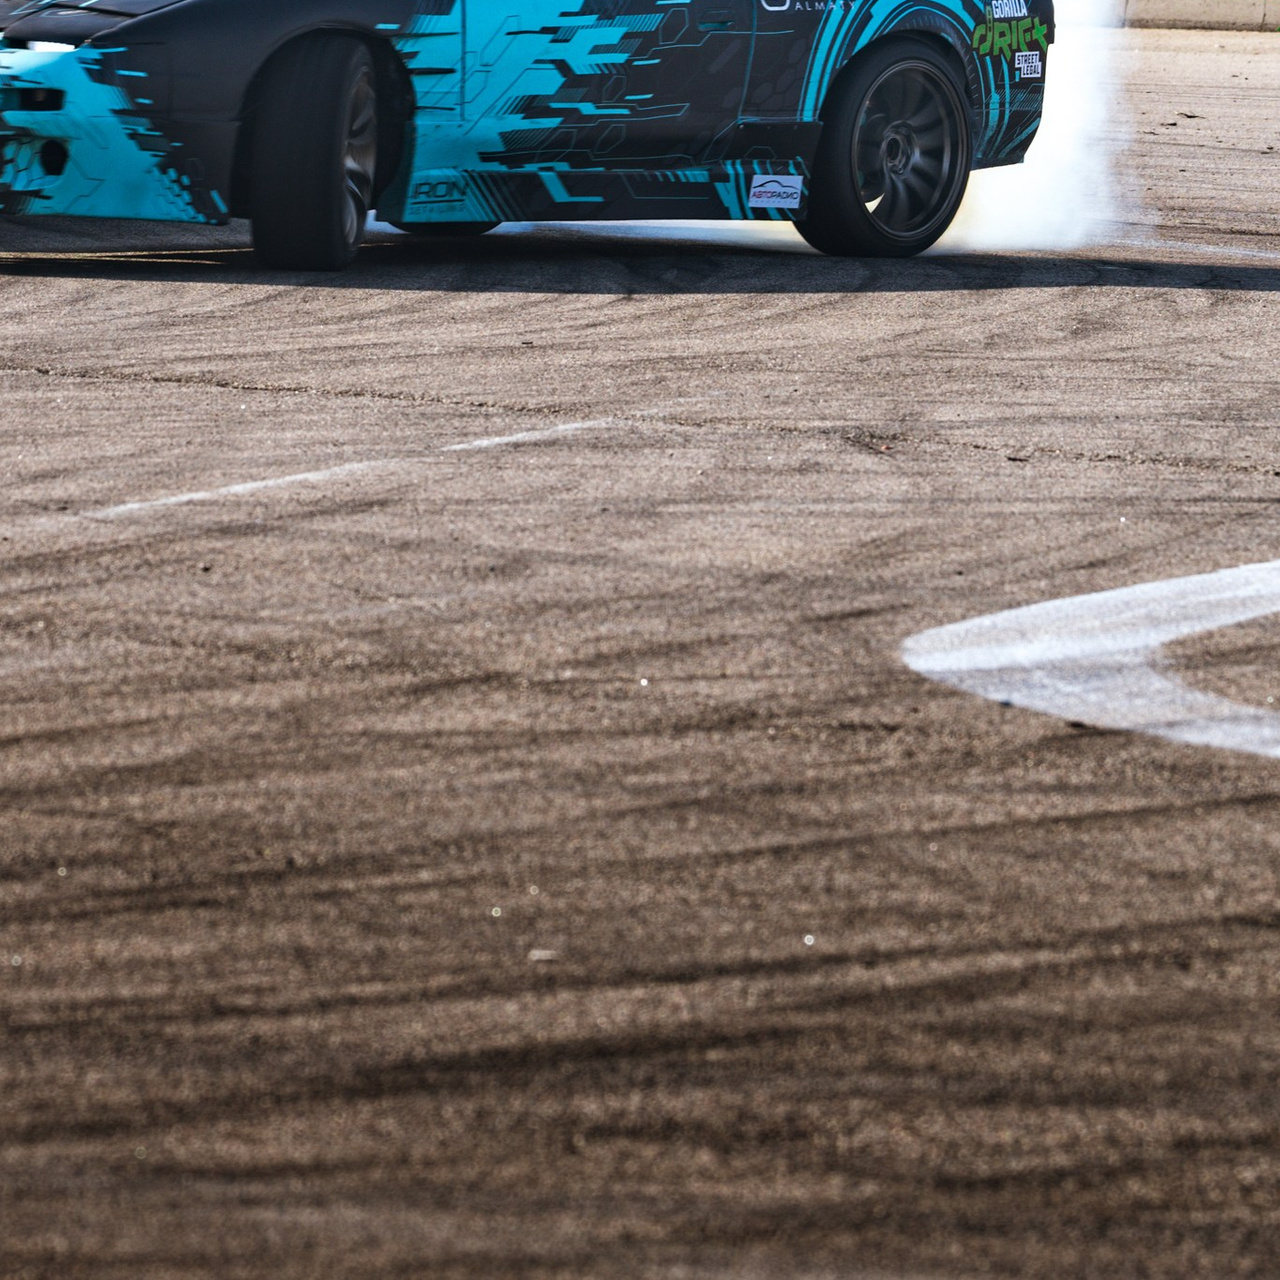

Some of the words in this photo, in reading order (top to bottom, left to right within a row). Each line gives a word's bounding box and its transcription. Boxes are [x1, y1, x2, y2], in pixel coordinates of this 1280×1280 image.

[795, 1, 855, 11] ALMATY
[1016, 53, 1039, 65] STREET
[1022, 64, 1040, 77] LEGAL
[752, 190, 799, 200] АВТОРАДИО
